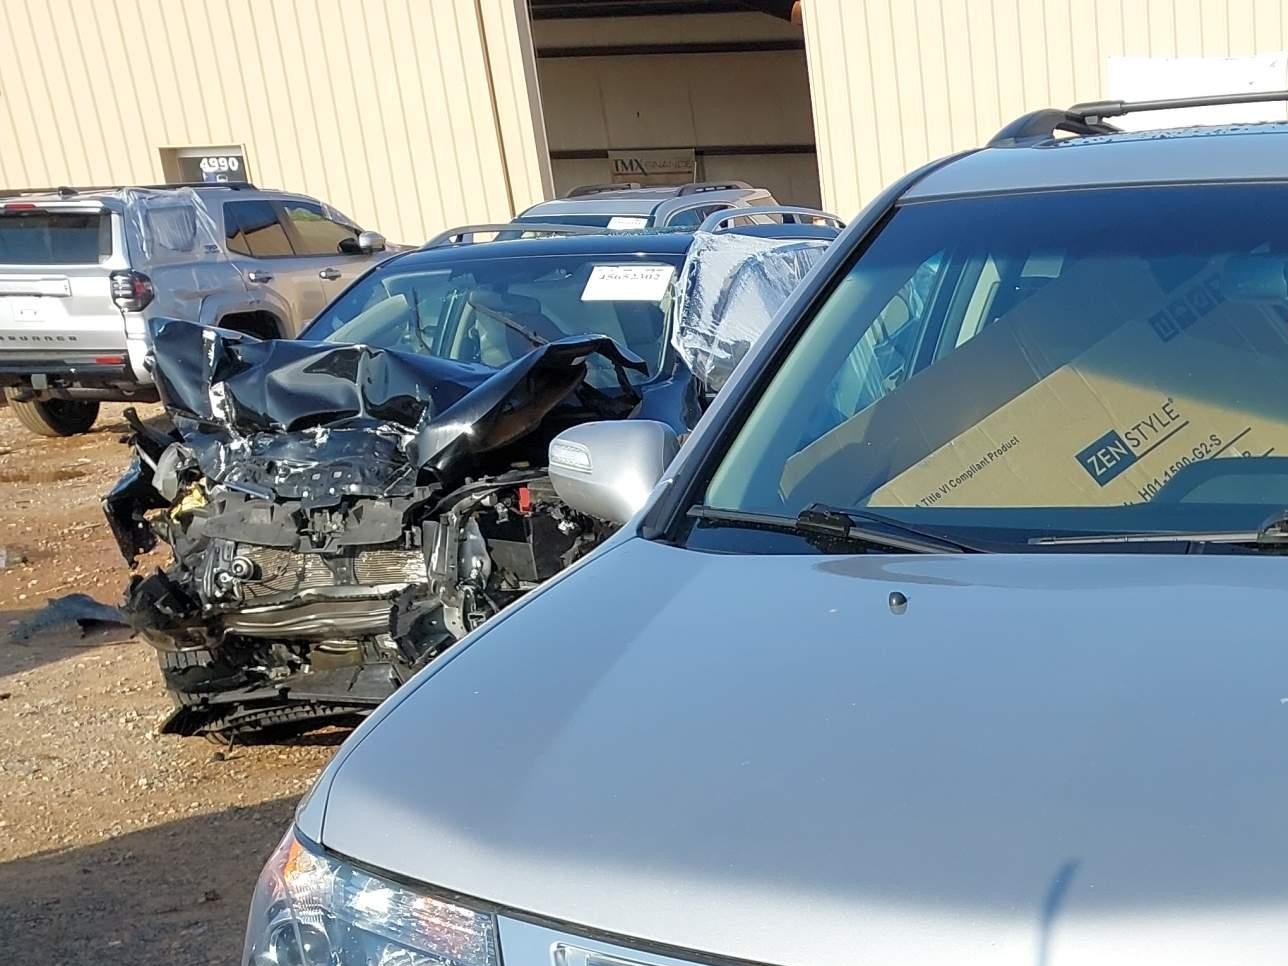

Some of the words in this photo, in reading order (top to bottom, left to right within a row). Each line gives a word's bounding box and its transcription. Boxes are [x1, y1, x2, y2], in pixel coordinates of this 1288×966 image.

[200, 157, 239, 172] 4990
[614, 159, 648, 176] TMX
[1087, 440, 1128, 476] ZEN
[921, 491, 942, 507] Title
[948, 456, 990, 488] Compliant
[987, 436, 1020, 462] Product
